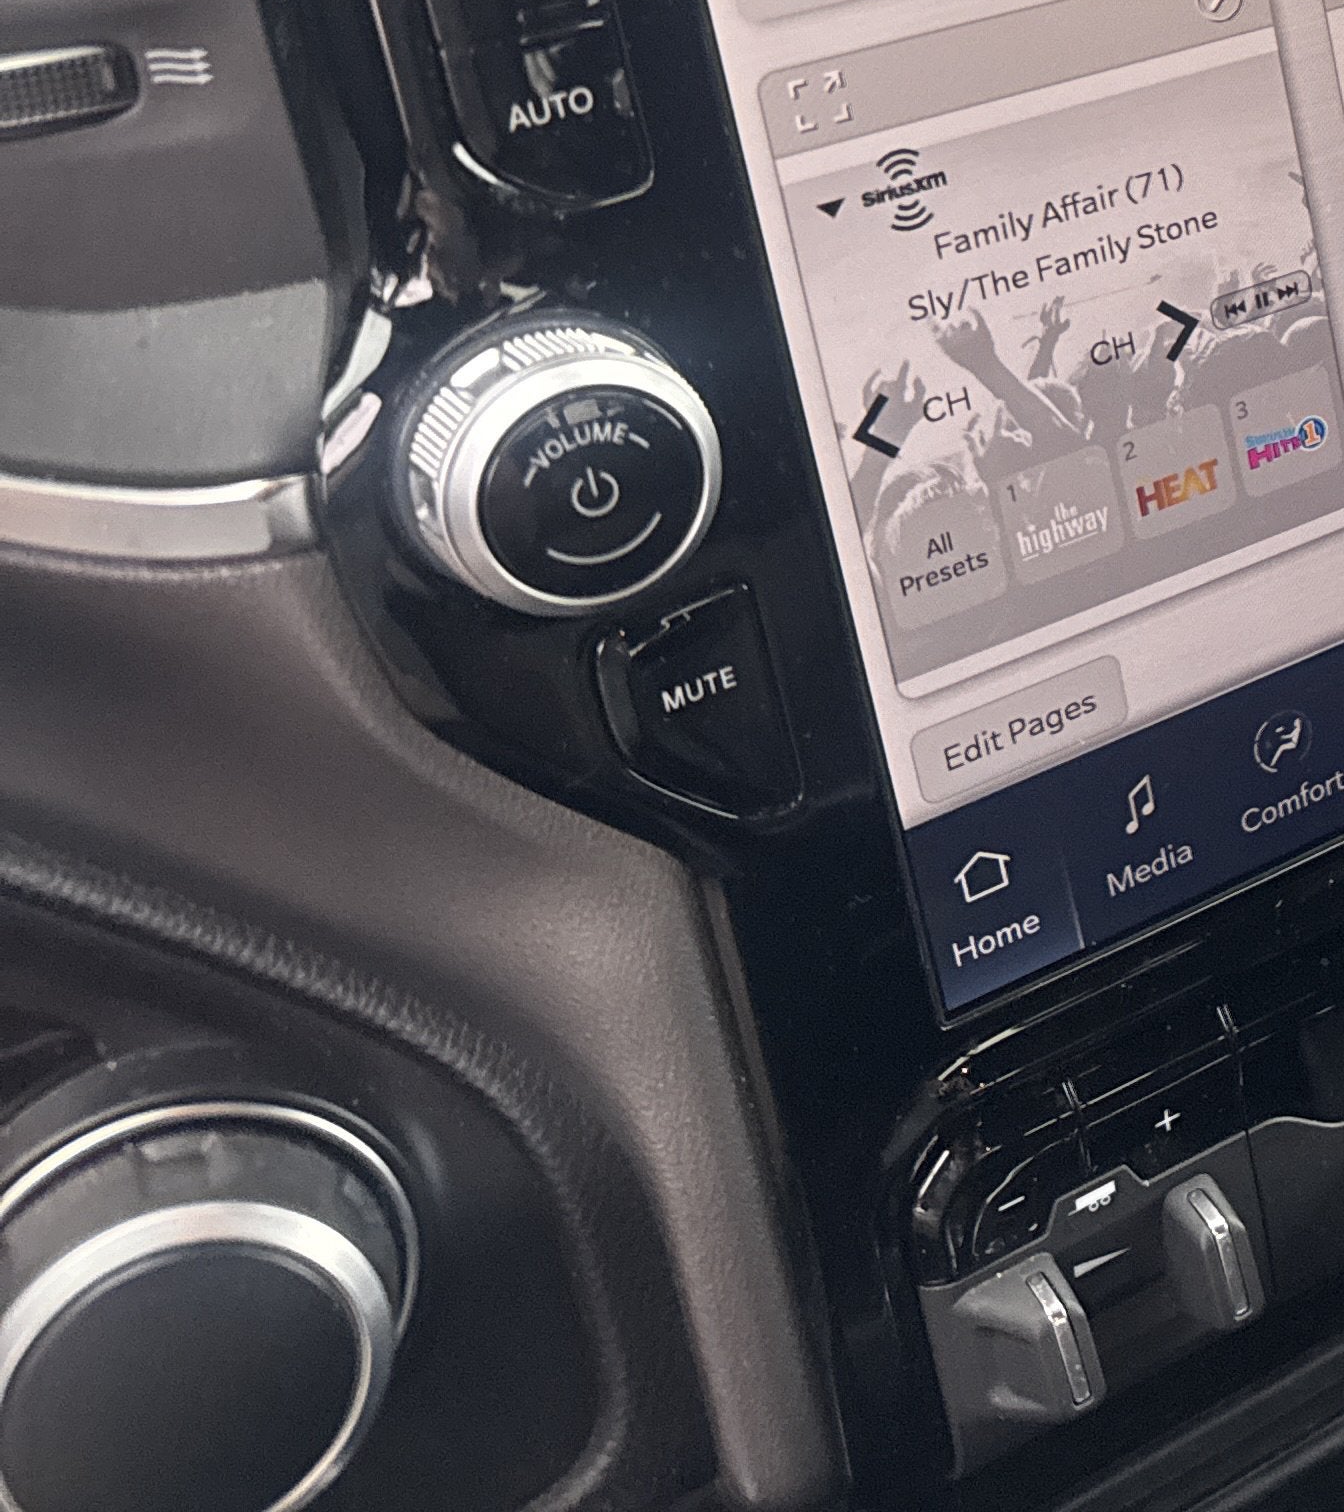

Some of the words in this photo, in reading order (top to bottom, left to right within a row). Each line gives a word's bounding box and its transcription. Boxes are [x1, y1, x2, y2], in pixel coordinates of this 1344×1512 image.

[508, 87, 594, 134] AUTO
[933, 210, 1034, 260] Family
[1041, 182, 1119, 229] Affair
[1123, 162, 1185, 206] (71)
[907, 268, 1030, 324] Sly/The
[1035, 231, 1132, 282] Family
[1137, 208, 1219, 251] Stone
[1089, 333, 1137, 368] CH
[921, 387, 972, 424] CH
[1235, 400, 1249, 420] 3
[531, 422, 629, 472] VOLUME
[1123, 441, 1139, 462] 2
[1006, 484, 1017, 503] 1
[1135, 458, 1219, 518] HEAT
[1016, 506, 1110, 554] highway
[1054, 502, 1078, 522] the
[926, 531, 954, 559] All
[900, 550, 990, 597] Presets
[661, 665, 738, 714] MUTE
[944, 728, 1005, 772] Edit
[1007, 694, 1098, 745] Pages
[1106, 844, 1194, 897] Media
[951, 913, 1041, 967] Home
